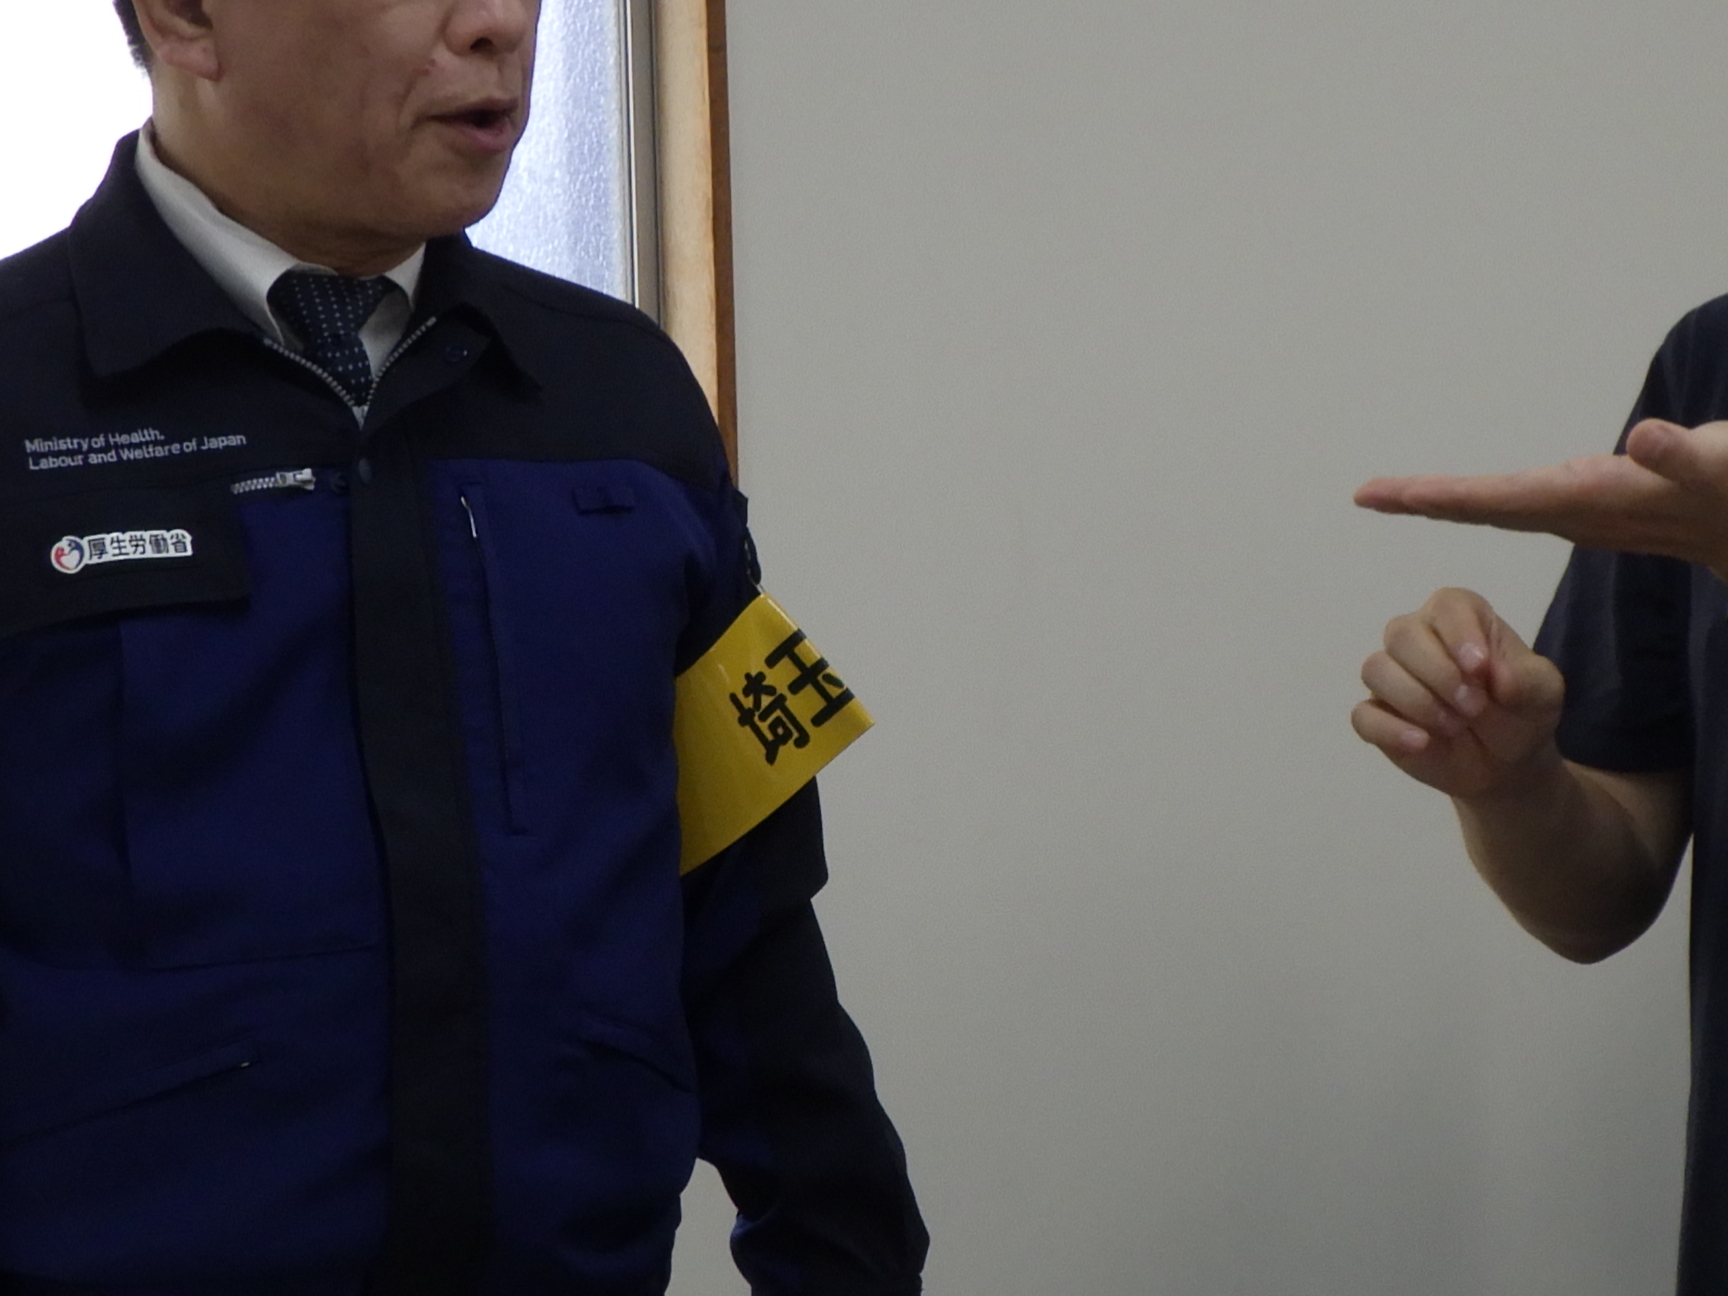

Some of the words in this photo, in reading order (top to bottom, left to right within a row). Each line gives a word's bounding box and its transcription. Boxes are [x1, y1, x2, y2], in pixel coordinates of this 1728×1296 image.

[25, 436, 90, 454] Ministry
[90, 433, 106, 449] of
[29, 454, 84, 471] Labour
[88, 448, 118, 464] and
[120, 442, 181, 461] Welfare
[183, 438, 198, 453] of
[200, 434, 247, 451] Japan
[87, 532, 190, 561] 厚生労働省
[729, 627, 856, 766] 埼玉
